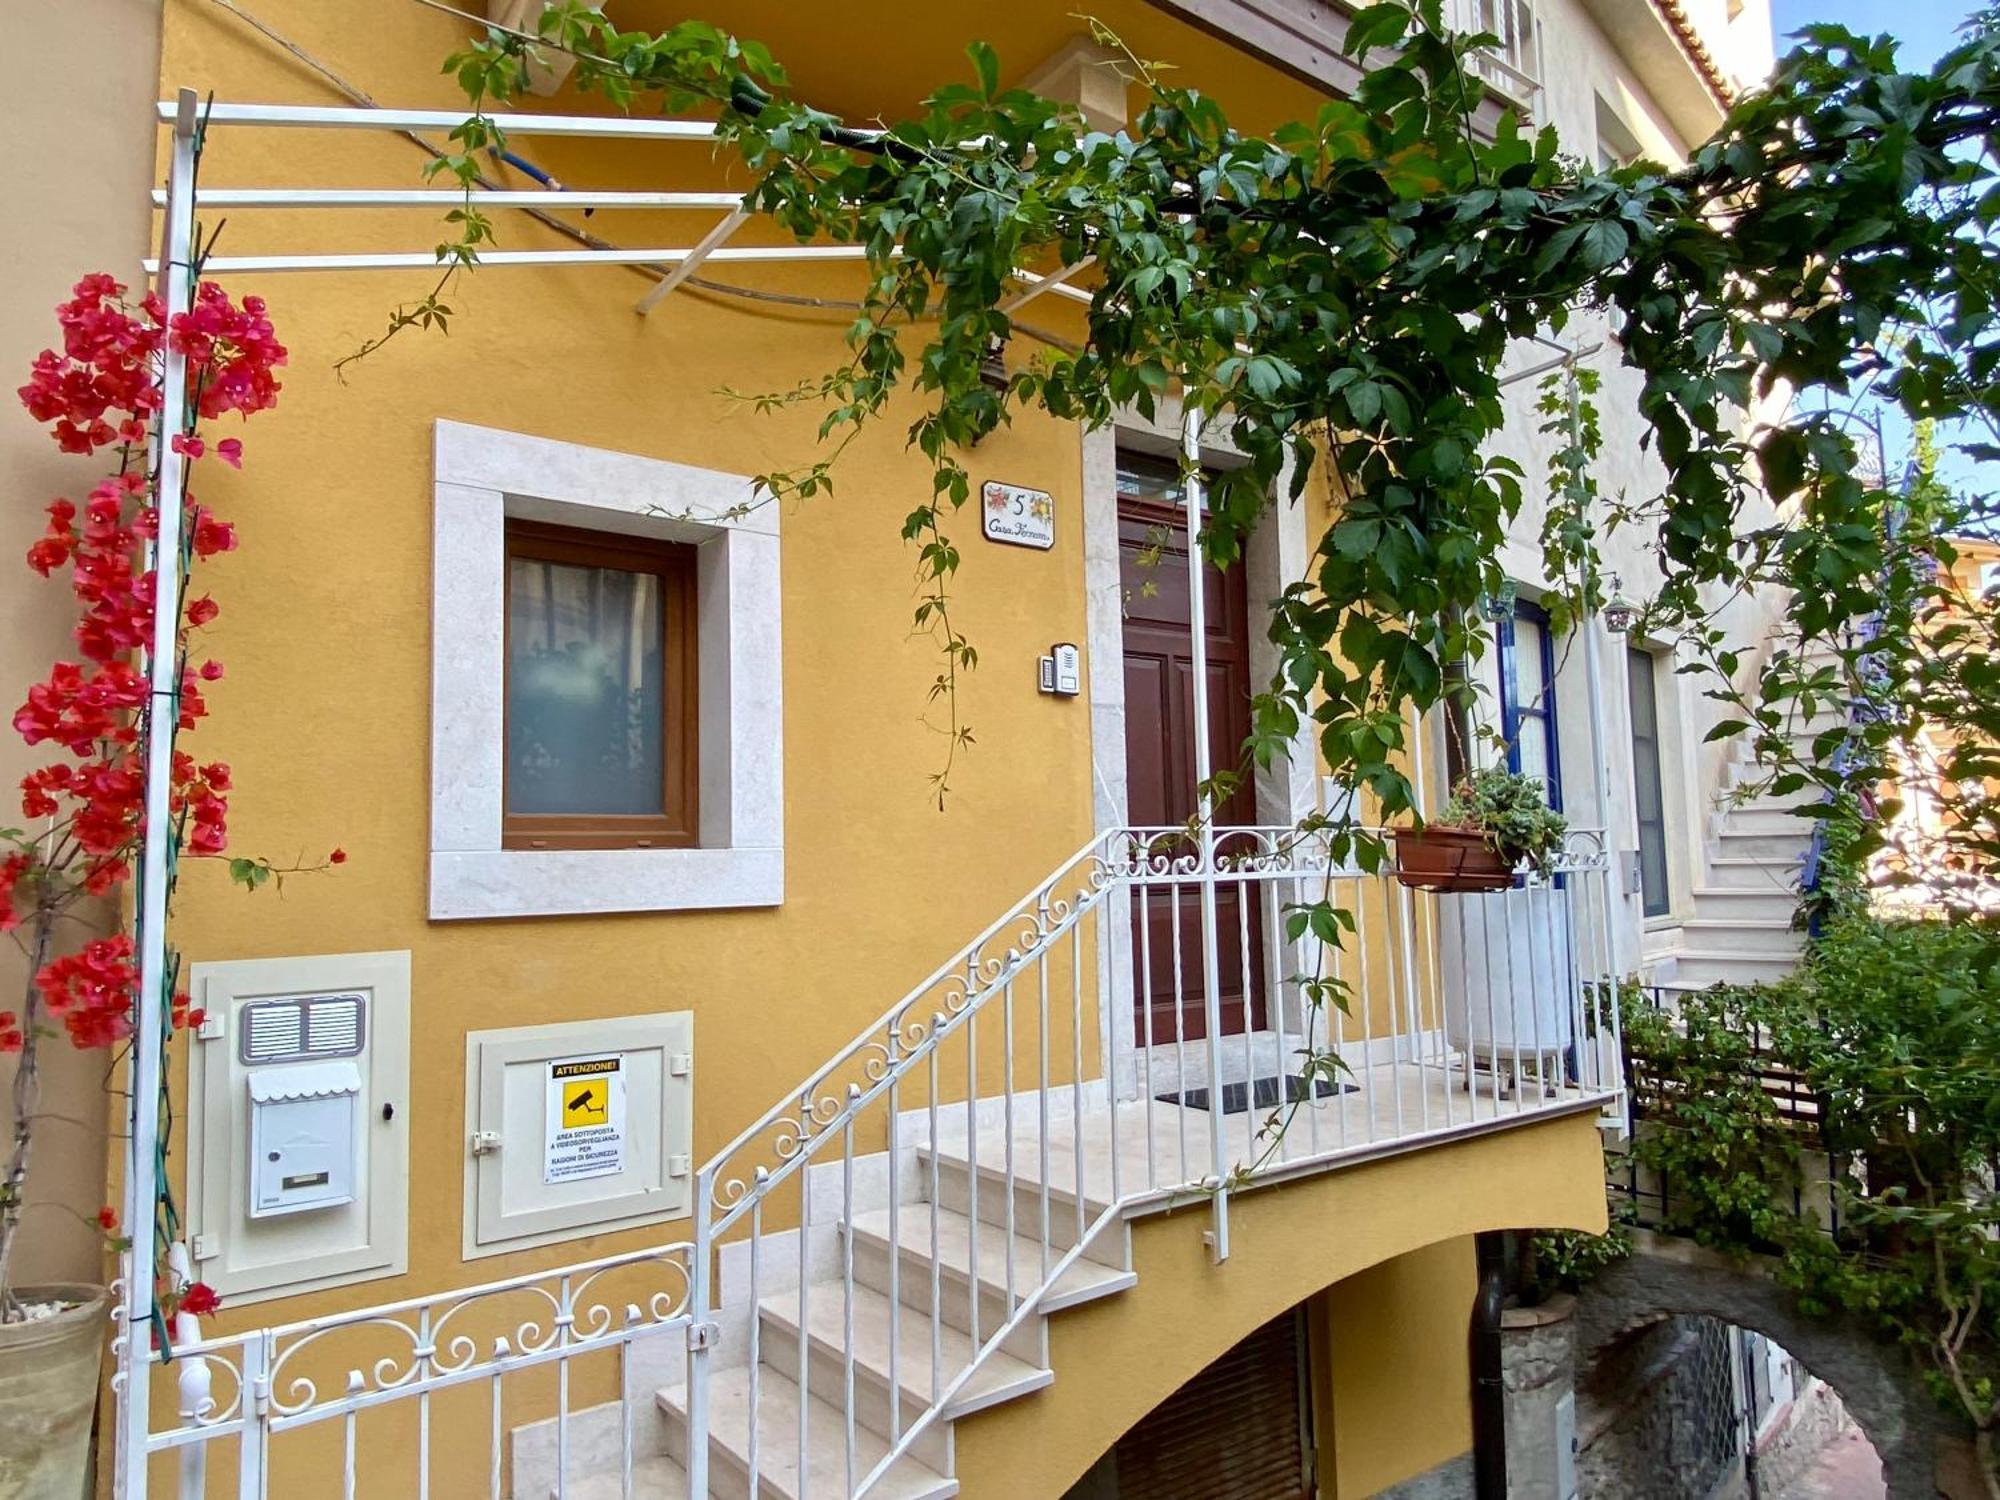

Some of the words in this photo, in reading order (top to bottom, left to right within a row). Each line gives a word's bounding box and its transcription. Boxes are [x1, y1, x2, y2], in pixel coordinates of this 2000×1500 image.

[1013, 494, 1025, 516] 5
[988, 518, 1012, 535] Casa
[556, 1061, 617, 1076] ATTENZIONE!
[556, 1132, 573, 1141] AREA
[574, 1127, 614, 1138] SOTTOPOSTA
[552, 1155, 577, 1164] RAGIONI
[585, 1149, 618, 1159] SICUREZZA
[579, 1145, 592, 1153] PER
